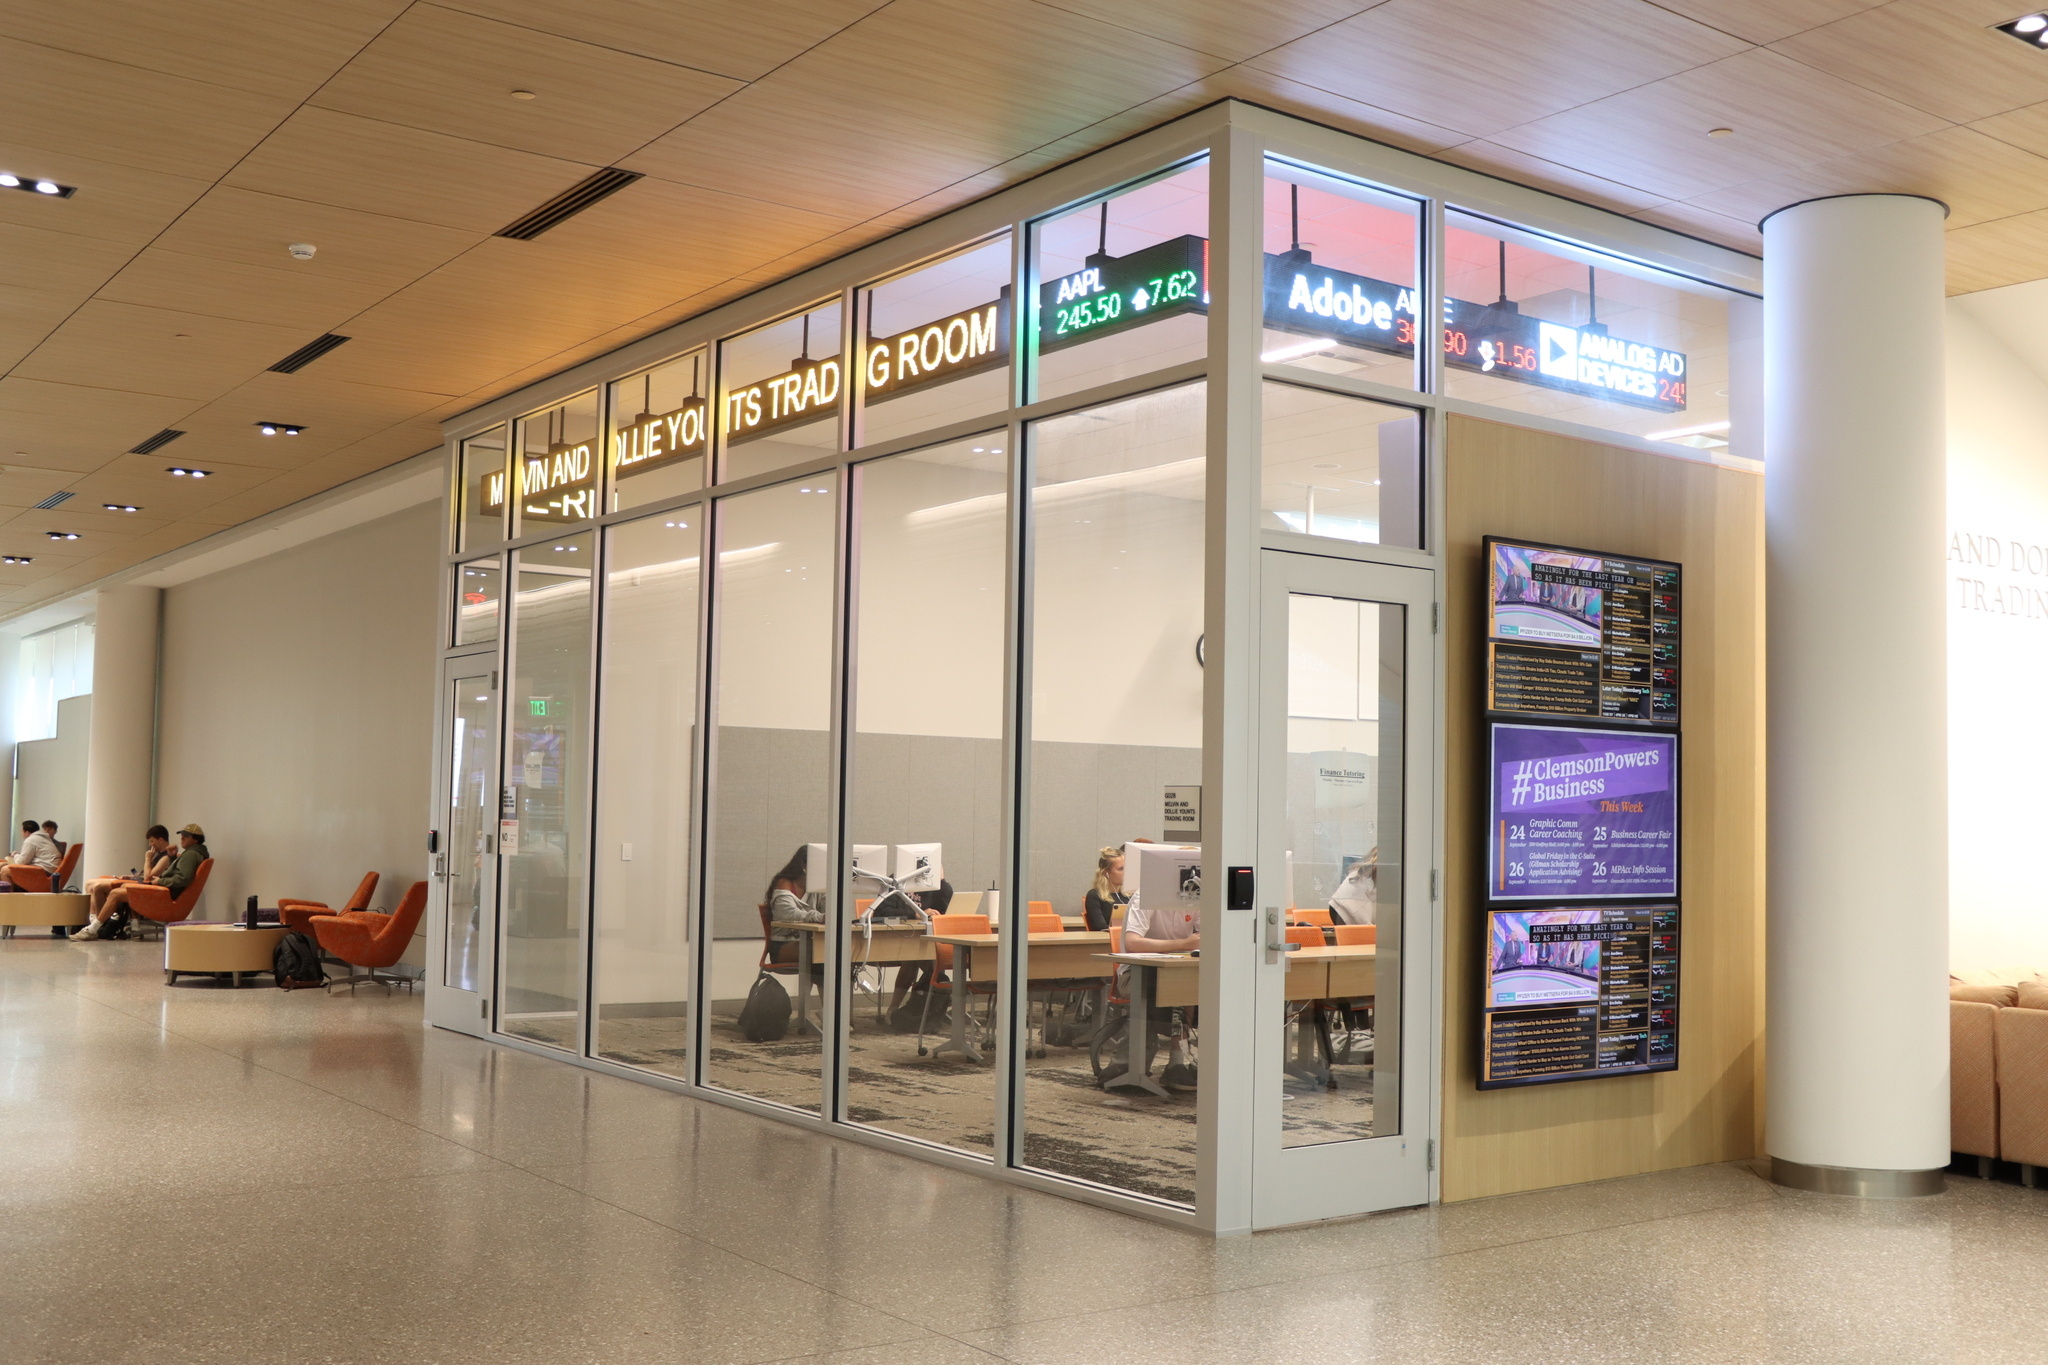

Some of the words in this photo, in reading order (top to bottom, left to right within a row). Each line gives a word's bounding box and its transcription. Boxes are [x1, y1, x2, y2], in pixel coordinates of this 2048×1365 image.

[1057, 267, 1105, 304] AAPL
[1057, 292, 1121, 334] 245.50
[1149, 270, 1197, 306] 7.62
[1288, 274, 1392, 330] Adobe
[1496, 341, 1536, 372] 1.56
[1579, 332, 1656, 372] ANALOG
[1578, 358, 1656, 398] DEVICES
[551, 445, 590, 488] AND
[898, 306, 997, 380] ROOM
[1947, 530, 2001, 568] AND
[2010, 541, 2048, 577] DO
[1534, 564, 1566, 574] AMAZINGLY
[1595, 572, 1608, 580] LAST
[1534, 778, 1605, 803] Business
[1600, 801, 1620, 812] This
[1622, 802, 1644, 813] Week
[1530, 819, 1556, 829] Graphic
[1557, 819, 1578, 828] Comm
[1510, 825, 1525, 840] 24
[1530, 830, 1552, 838] Career
[1552, 830, 1583, 840] Coaching
[1593, 827, 1607, 840] 25
[1611, 830, 1637, 839] Business
[1638, 831, 1658, 839] Career
[1659, 831, 1672, 839] Fair
[1509, 862, 1524, 876] 26
[1592, 862, 1606, 876] 26
[1611, 865, 1632, 874] MPAcc
[1632, 865, 1644, 875] Info
[1645, 865, 1666, 874] Session
